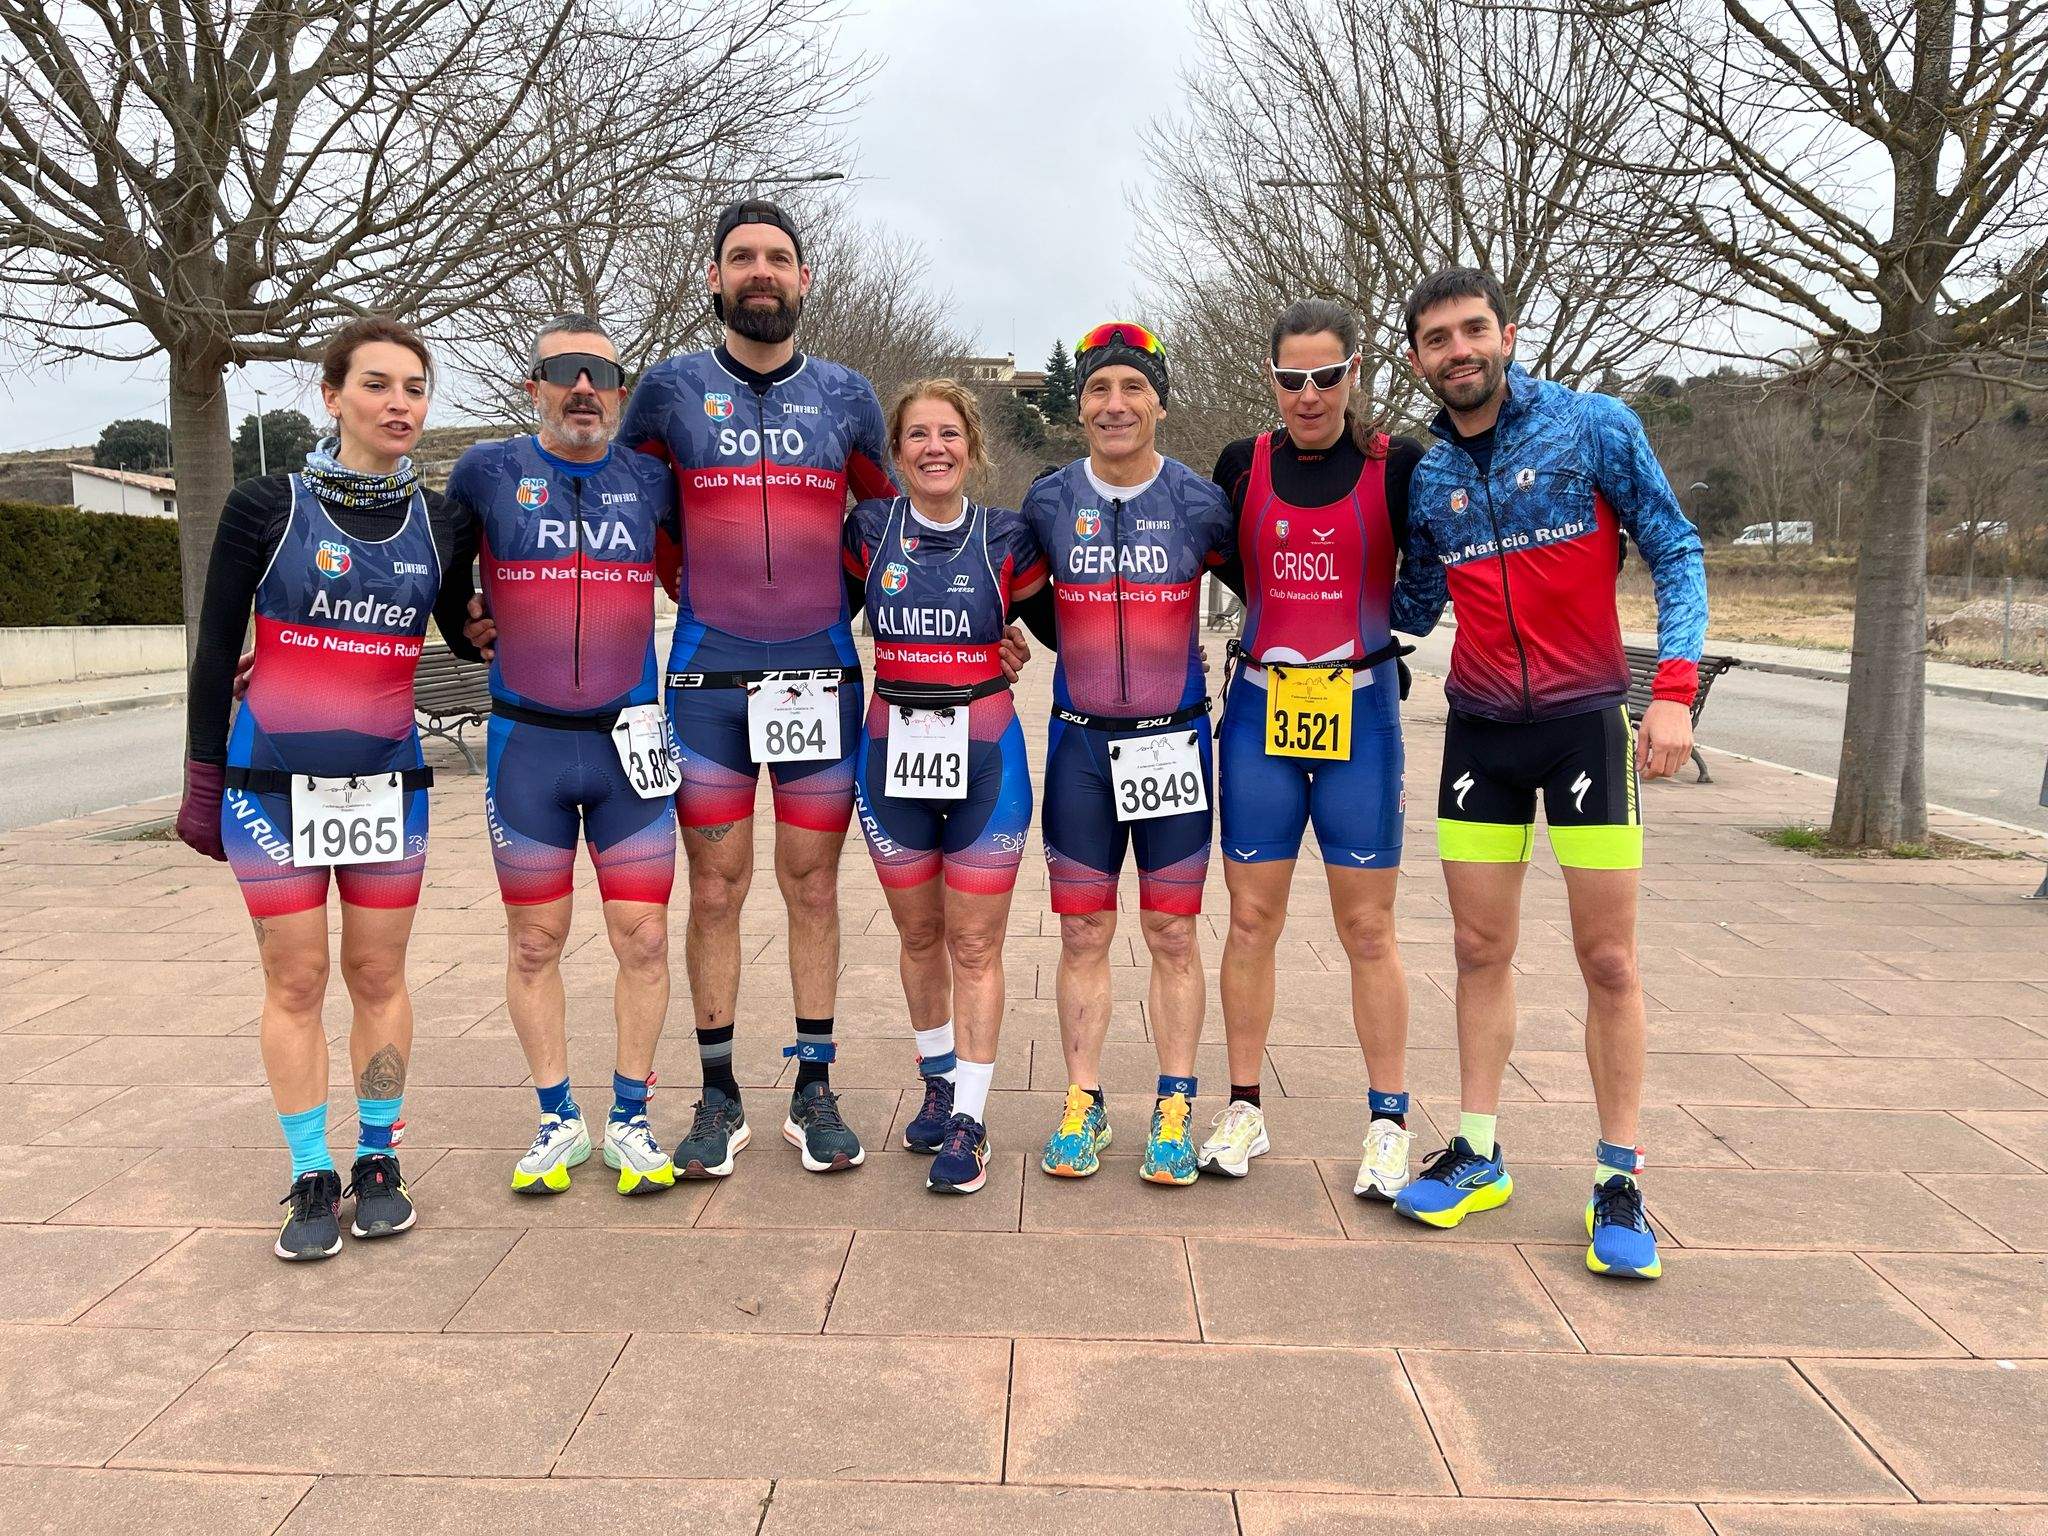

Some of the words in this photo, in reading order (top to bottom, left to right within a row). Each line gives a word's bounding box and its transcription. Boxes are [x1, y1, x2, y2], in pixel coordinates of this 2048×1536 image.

[719, 428, 804, 457] SOTO
[694, 474, 728, 488] Club
[732, 473, 801, 487] Natació
[805, 474, 836, 490] Rubí
[537, 519, 636, 551] RIVA
[1535, 519, 1584, 542] Rubí
[321, 542, 348, 553] CNR
[1069, 545, 1168, 574] GERARD
[497, 568, 535, 580] Club
[541, 567, 622, 582] Natació
[888, 563, 907, 573] CNR
[1273, 551, 1340, 581] CRISOL
[1058, 588, 1085, 602] Club
[1088, 590, 1156, 603] Natació
[1161, 587, 1191, 602] Rubí
[1269, 588, 1286, 599] Club
[1287, 590, 1319, 600] Natació
[1321, 590, 1343, 600] Rubí
[309, 590, 417, 628] Andrea
[878, 606, 971, 637] ALMEIDA
[280, 630, 319, 648] Club
[323, 636, 391, 656] Natació
[876, 647, 895, 661] Club
[897, 650, 953, 663] Natació
[956, 651, 987, 663] Rubí
[1059, 710, 1089, 725] 2XU
[1136, 716, 1172, 729] 2XU
[1274, 710, 1339, 751] 3.521
[766, 718, 826, 755] 864
[893, 752, 960, 788] 4443
[1120, 771, 1199, 813] 3849
[486, 797, 513, 848] Rubí
[862, 816, 903, 857] Rubí
[300, 817, 398, 859] 1965
